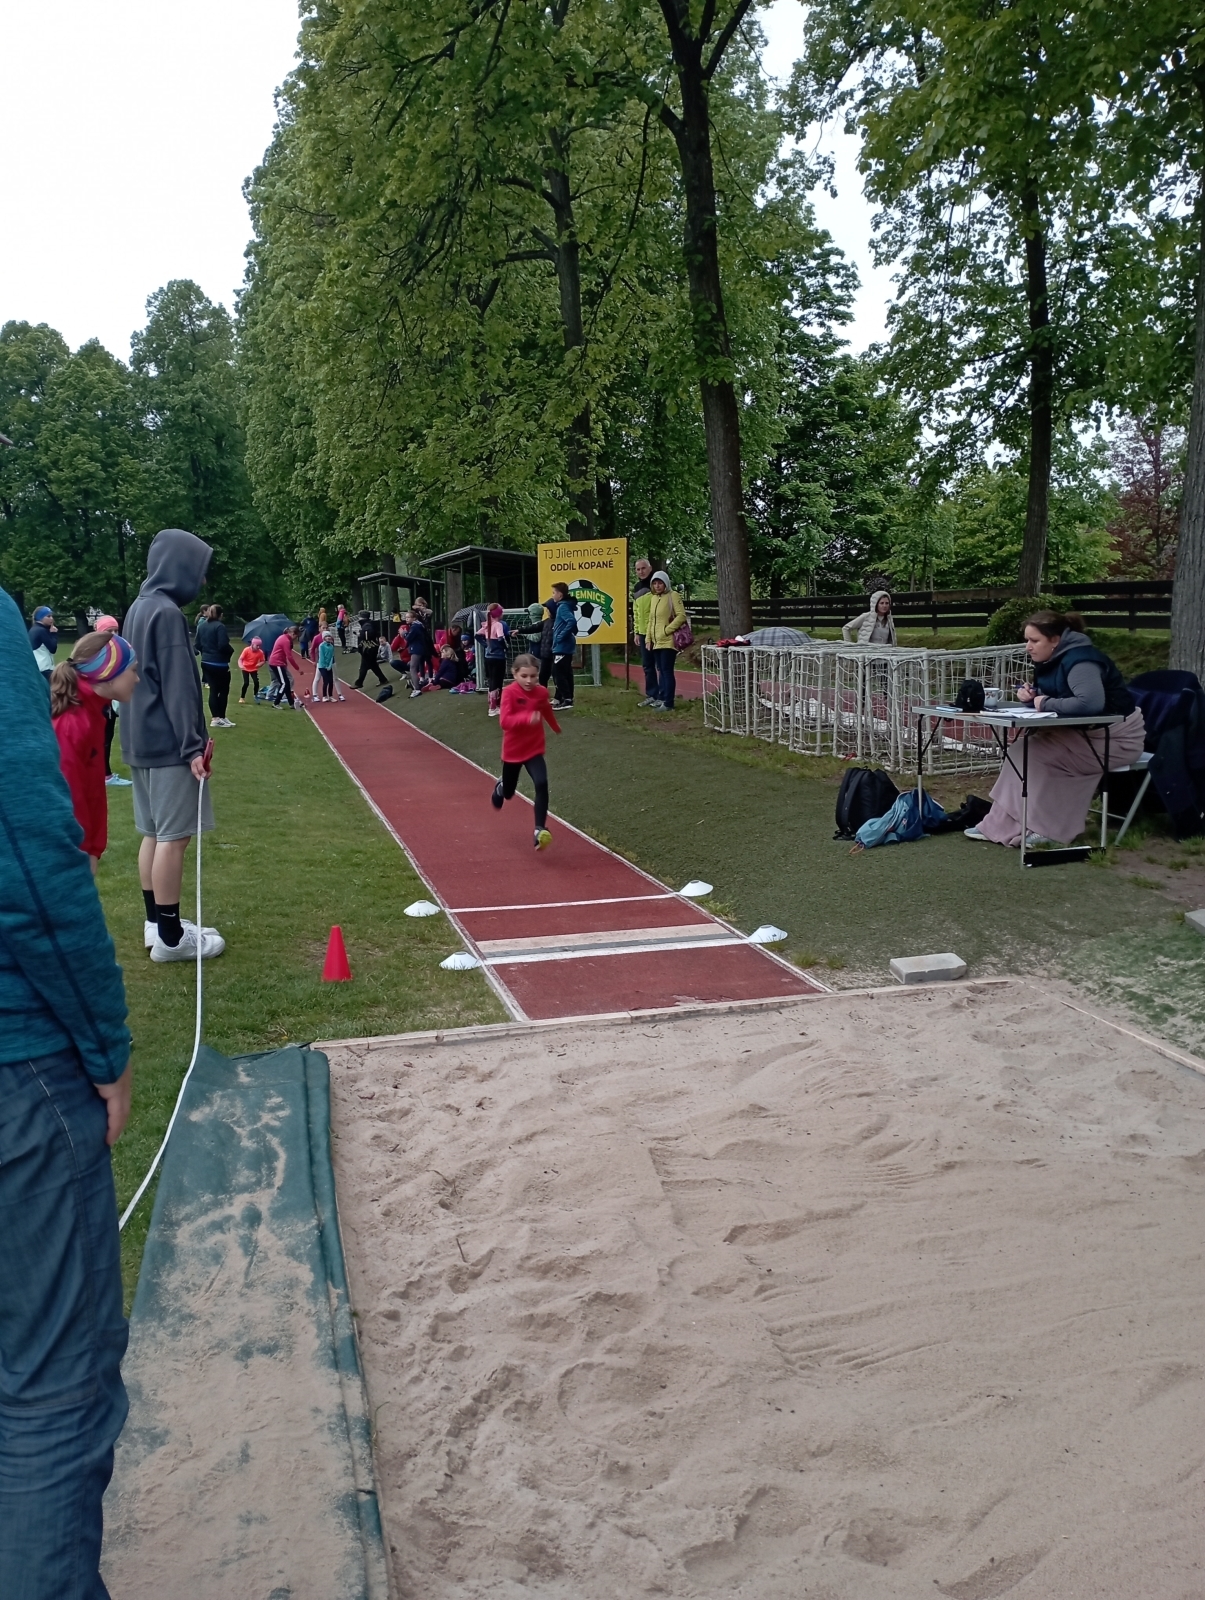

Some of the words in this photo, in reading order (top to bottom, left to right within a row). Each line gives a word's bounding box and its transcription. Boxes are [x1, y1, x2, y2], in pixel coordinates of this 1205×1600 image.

[543, 549, 553, 559] TJ
[556, 546, 604, 559] Jilemnice
[550, 561, 576, 572] ODDÍL
[578, 558, 614, 570] KOPANÉ
